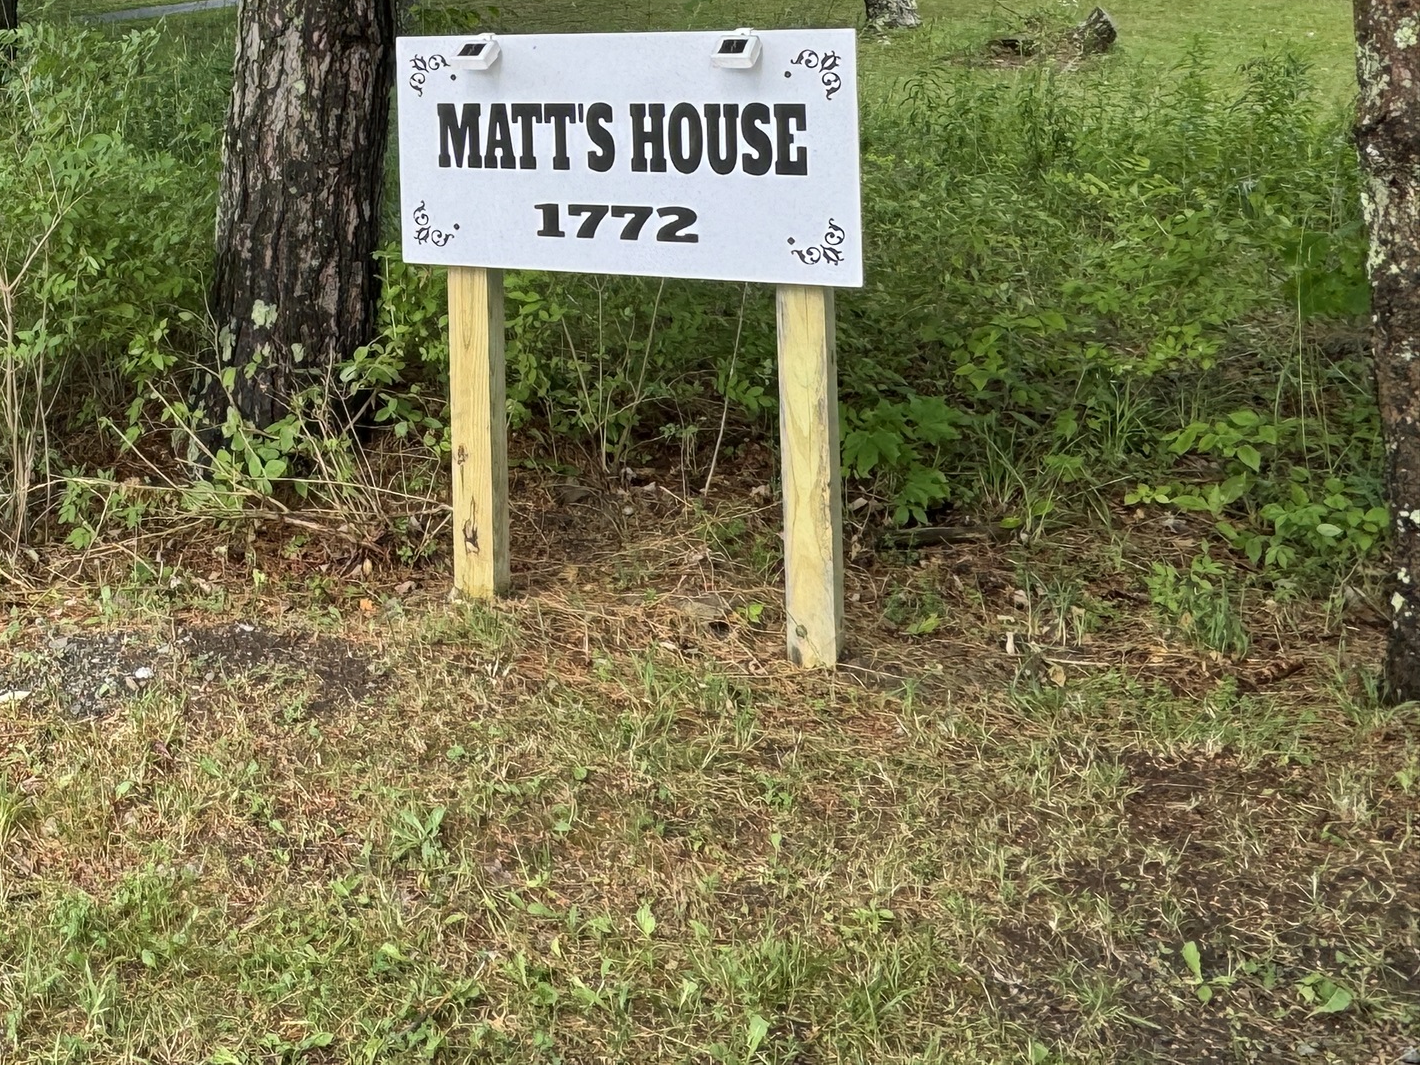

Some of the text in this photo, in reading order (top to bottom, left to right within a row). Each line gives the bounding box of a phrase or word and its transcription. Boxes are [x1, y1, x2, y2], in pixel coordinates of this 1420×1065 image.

[437, 102, 808, 176] MATT'S HOUSE
[534, 203, 700, 243] 1772
